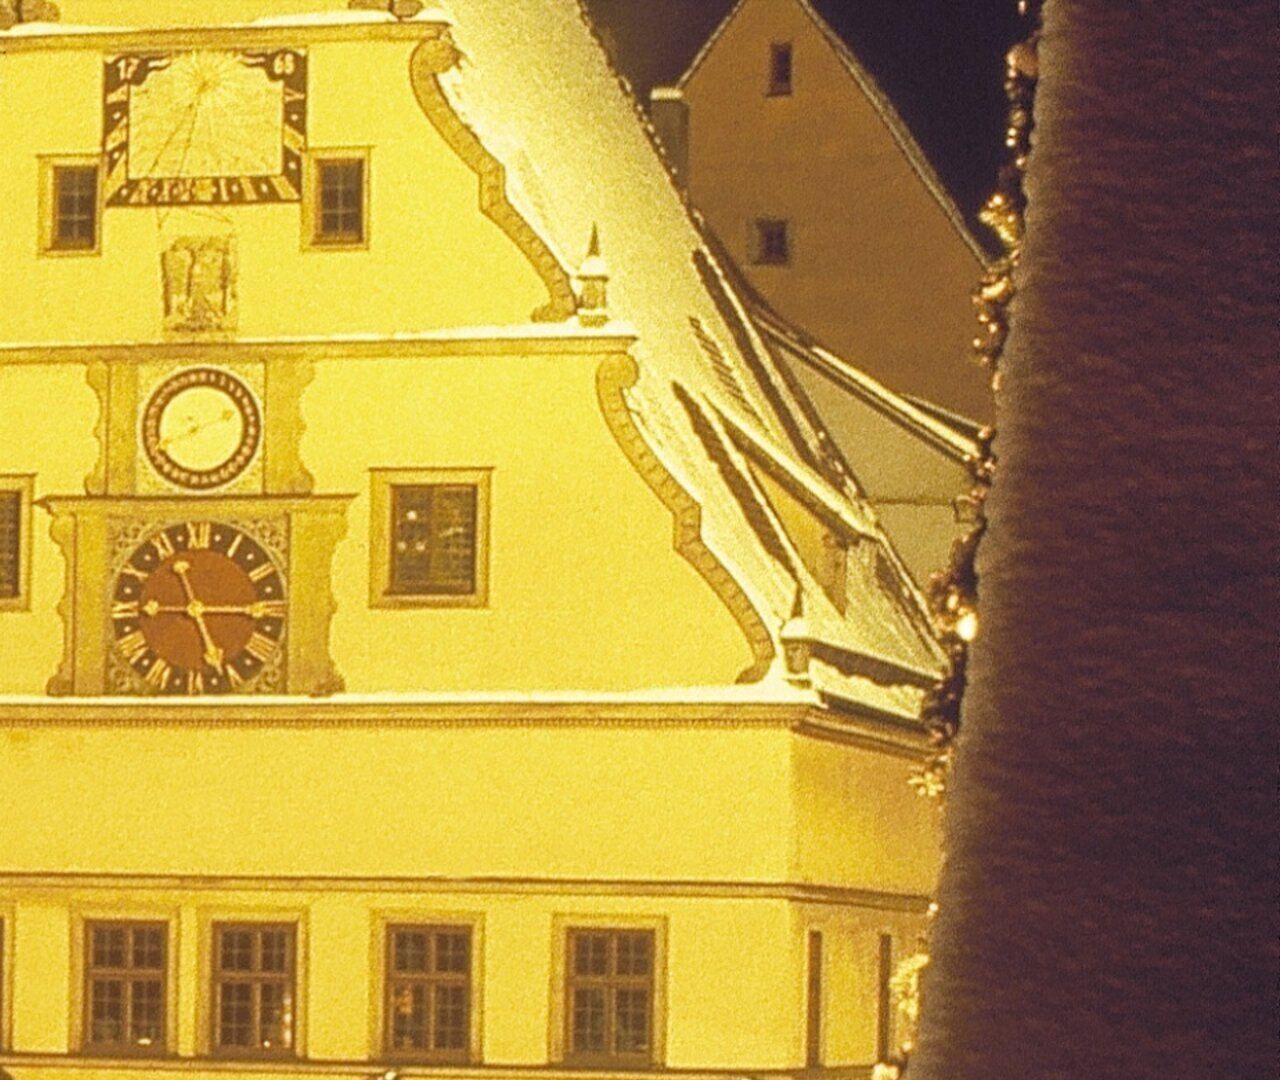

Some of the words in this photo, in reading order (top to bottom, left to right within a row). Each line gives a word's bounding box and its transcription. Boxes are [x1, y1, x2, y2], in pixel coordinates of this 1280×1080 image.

[116, 58, 140, 82] 17
[186, 522, 211, 549] XII
[227, 533, 243, 559] I
[248, 561, 276, 583] II
